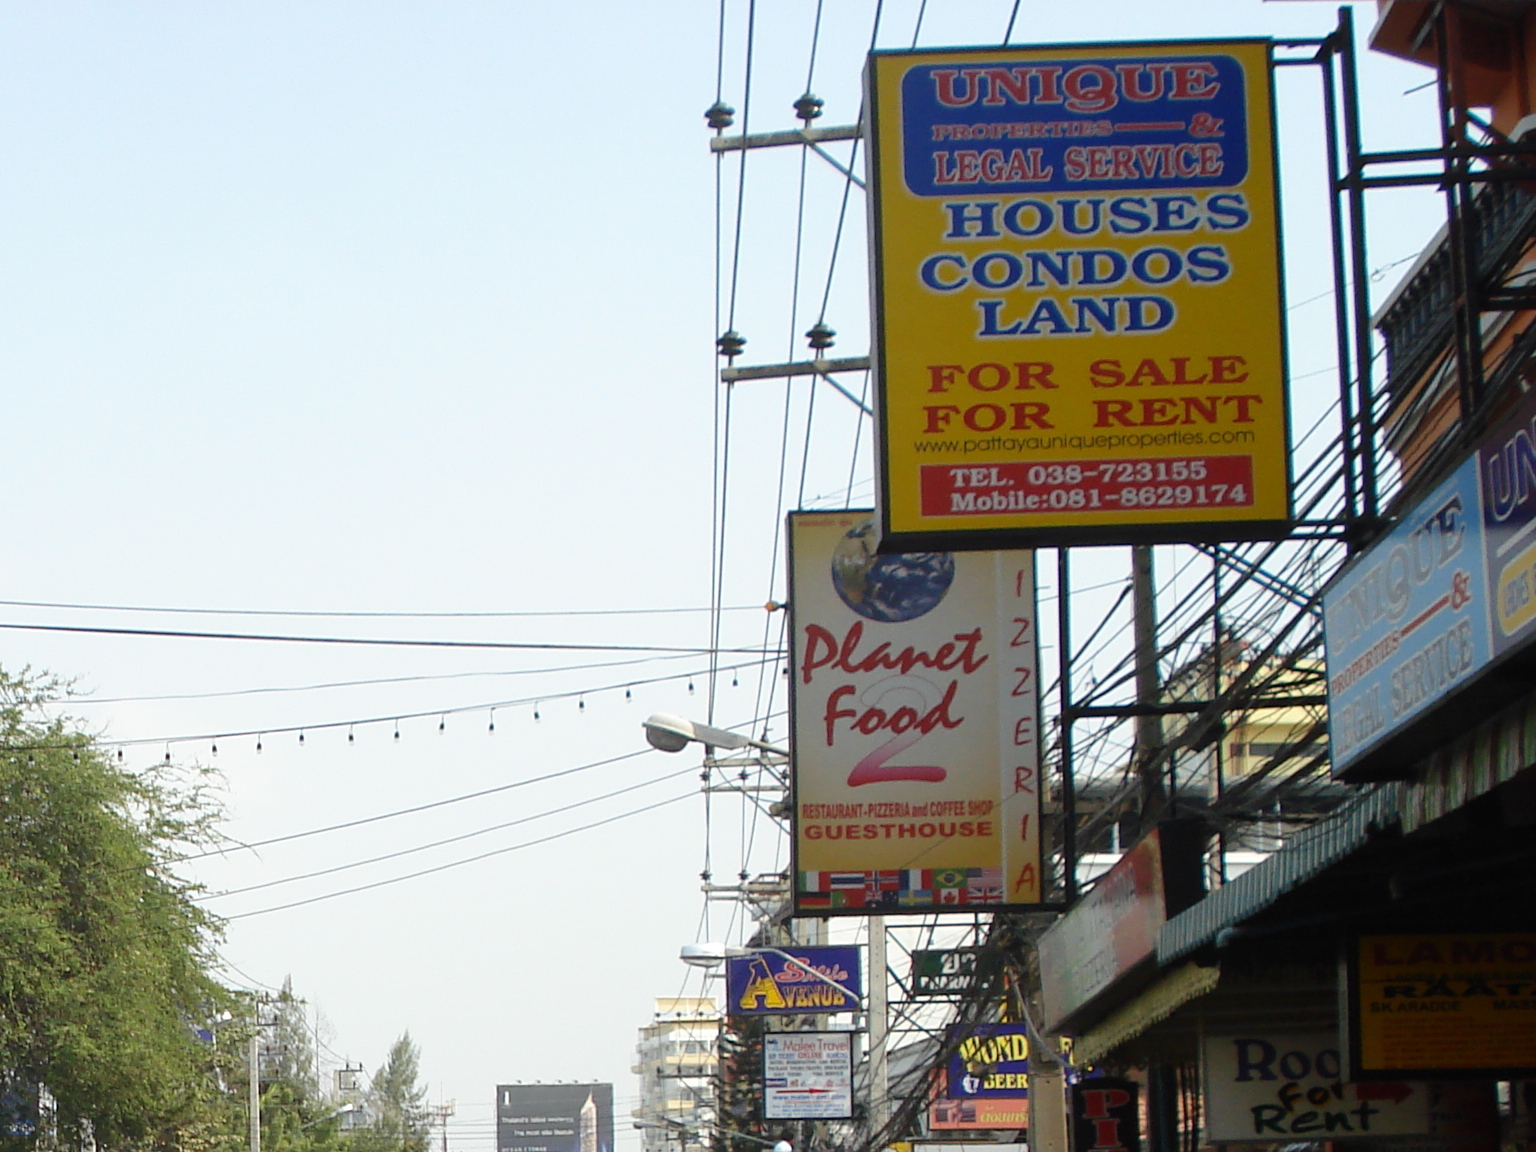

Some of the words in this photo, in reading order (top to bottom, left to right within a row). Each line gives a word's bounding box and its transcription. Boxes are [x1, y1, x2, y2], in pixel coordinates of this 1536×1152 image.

[930, 61, 1220, 113] UNIQUE
[932, 119, 1114, 141] PROPERTIES
[1188, 113, 1225, 138] &
[933, 148, 1053, 185] LEGAL
[1064, 142, 1224, 181] SERVICE
[943, 193, 1251, 240] HOUSES
[920, 245, 1231, 291] CONDOS
[977, 296, 1175, 337] LAND
[927, 361, 1059, 394] FOR
[1088, 355, 1250, 388] SALE
[923, 402, 1054, 434] FOR
[1093, 394, 1263, 428] RENT
[913, 430, 1256, 455] www.pattayauniqueproperties.com
[949, 468, 1015, 488] TEL.
[1027, 460, 1208, 486] 038-723155
[949, 484, 1247, 514] Mobile:081-8629174
[1325, 493, 1466, 655] UNIQUE
[801, 620, 989, 685] Planet
[1390, 616, 1473, 717] SERVICE
[824, 680, 964, 747] Food
[912, 803, 929, 817] and
[930, 801, 966, 817] COFFEE
[967, 799, 994, 816] SHOP
[804, 821, 994, 841] GUESTHOUSE
[817, 1036, 850, 1051] Travel
[983, 1073, 1029, 1090] BEER
[1251, 1100, 1379, 1134] Rent
